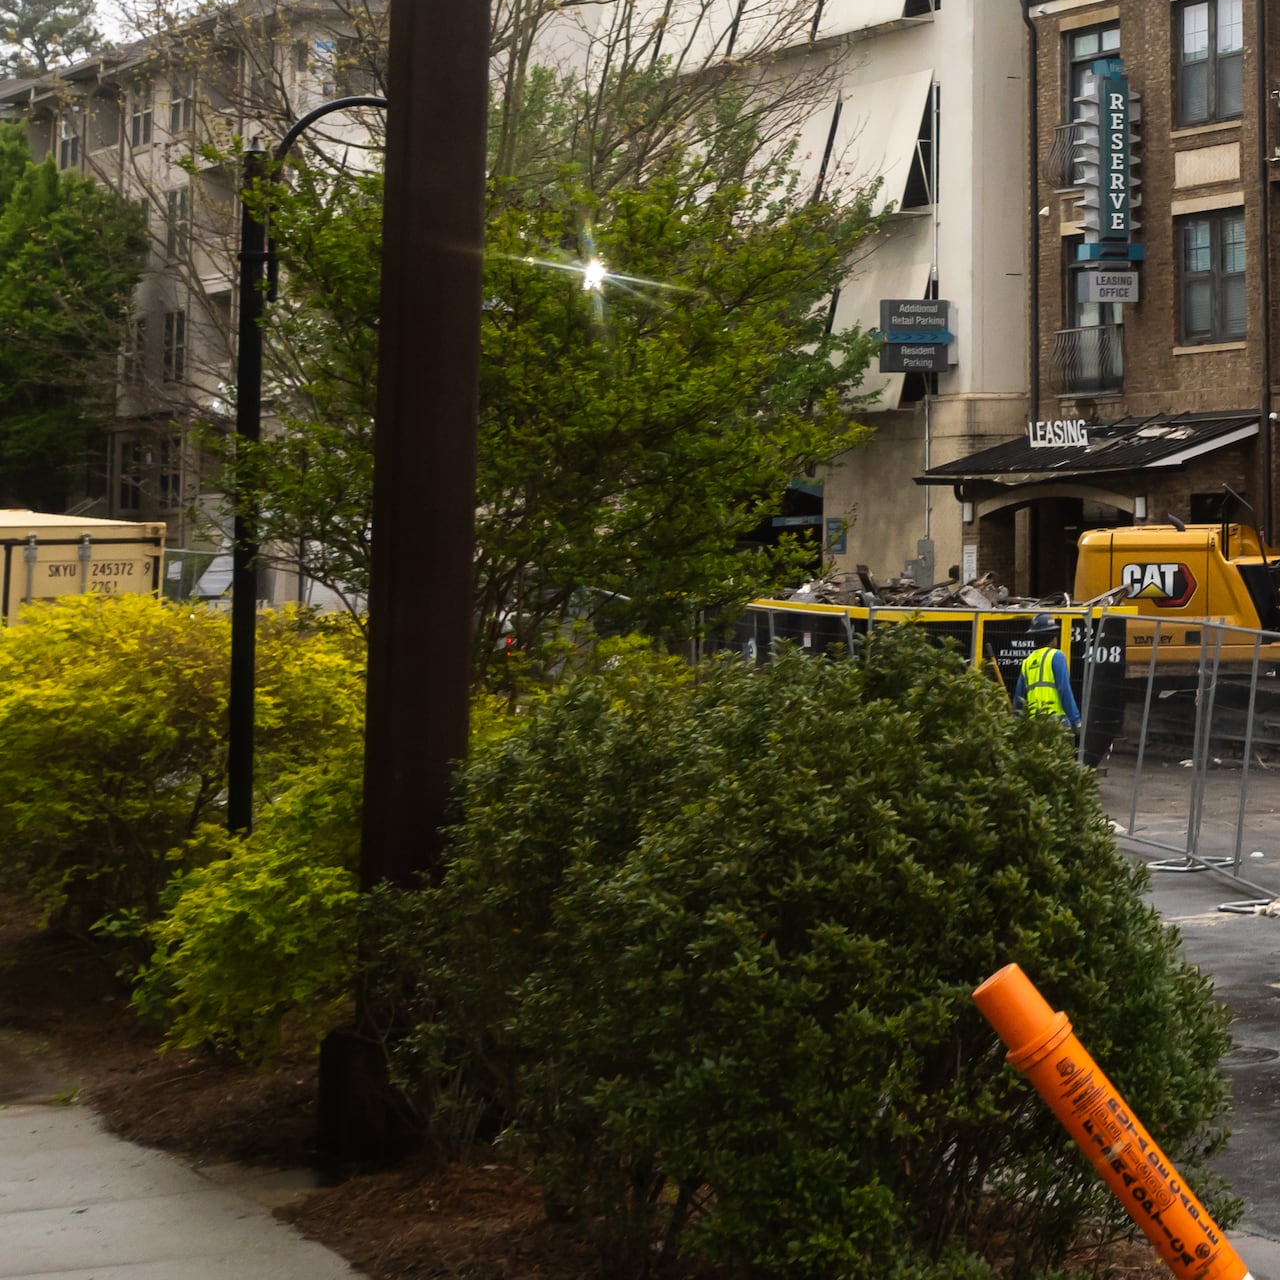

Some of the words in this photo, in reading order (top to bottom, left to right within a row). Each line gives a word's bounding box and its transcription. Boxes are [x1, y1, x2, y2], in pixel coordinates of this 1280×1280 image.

[1109, 93, 1125, 230] RESERVE
[1096, 276, 1132, 286] LEASING
[1099, 287, 1129, 297] OFFICE
[899, 303, 938, 313] Additional
[891, 315, 914, 325] Retail
[916, 315, 945, 326] Parking
[901, 345, 935, 355] Resident
[903, 358, 933, 368] Parking
[1029, 419, 1089, 448] LEASING
[48, 563, 76, 577] SKYU
[92, 562, 134, 576] 245372
[144, 561, 151, 575] 9
[1122, 563, 1178, 598] CAT
[1107, 1097, 1151, 1154] RUTA
[1147, 1151, 1170, 1180] DE
[1169, 1179, 1220, 1246] CABLE
[1132, 1187, 1197, 1268] OPTICA
